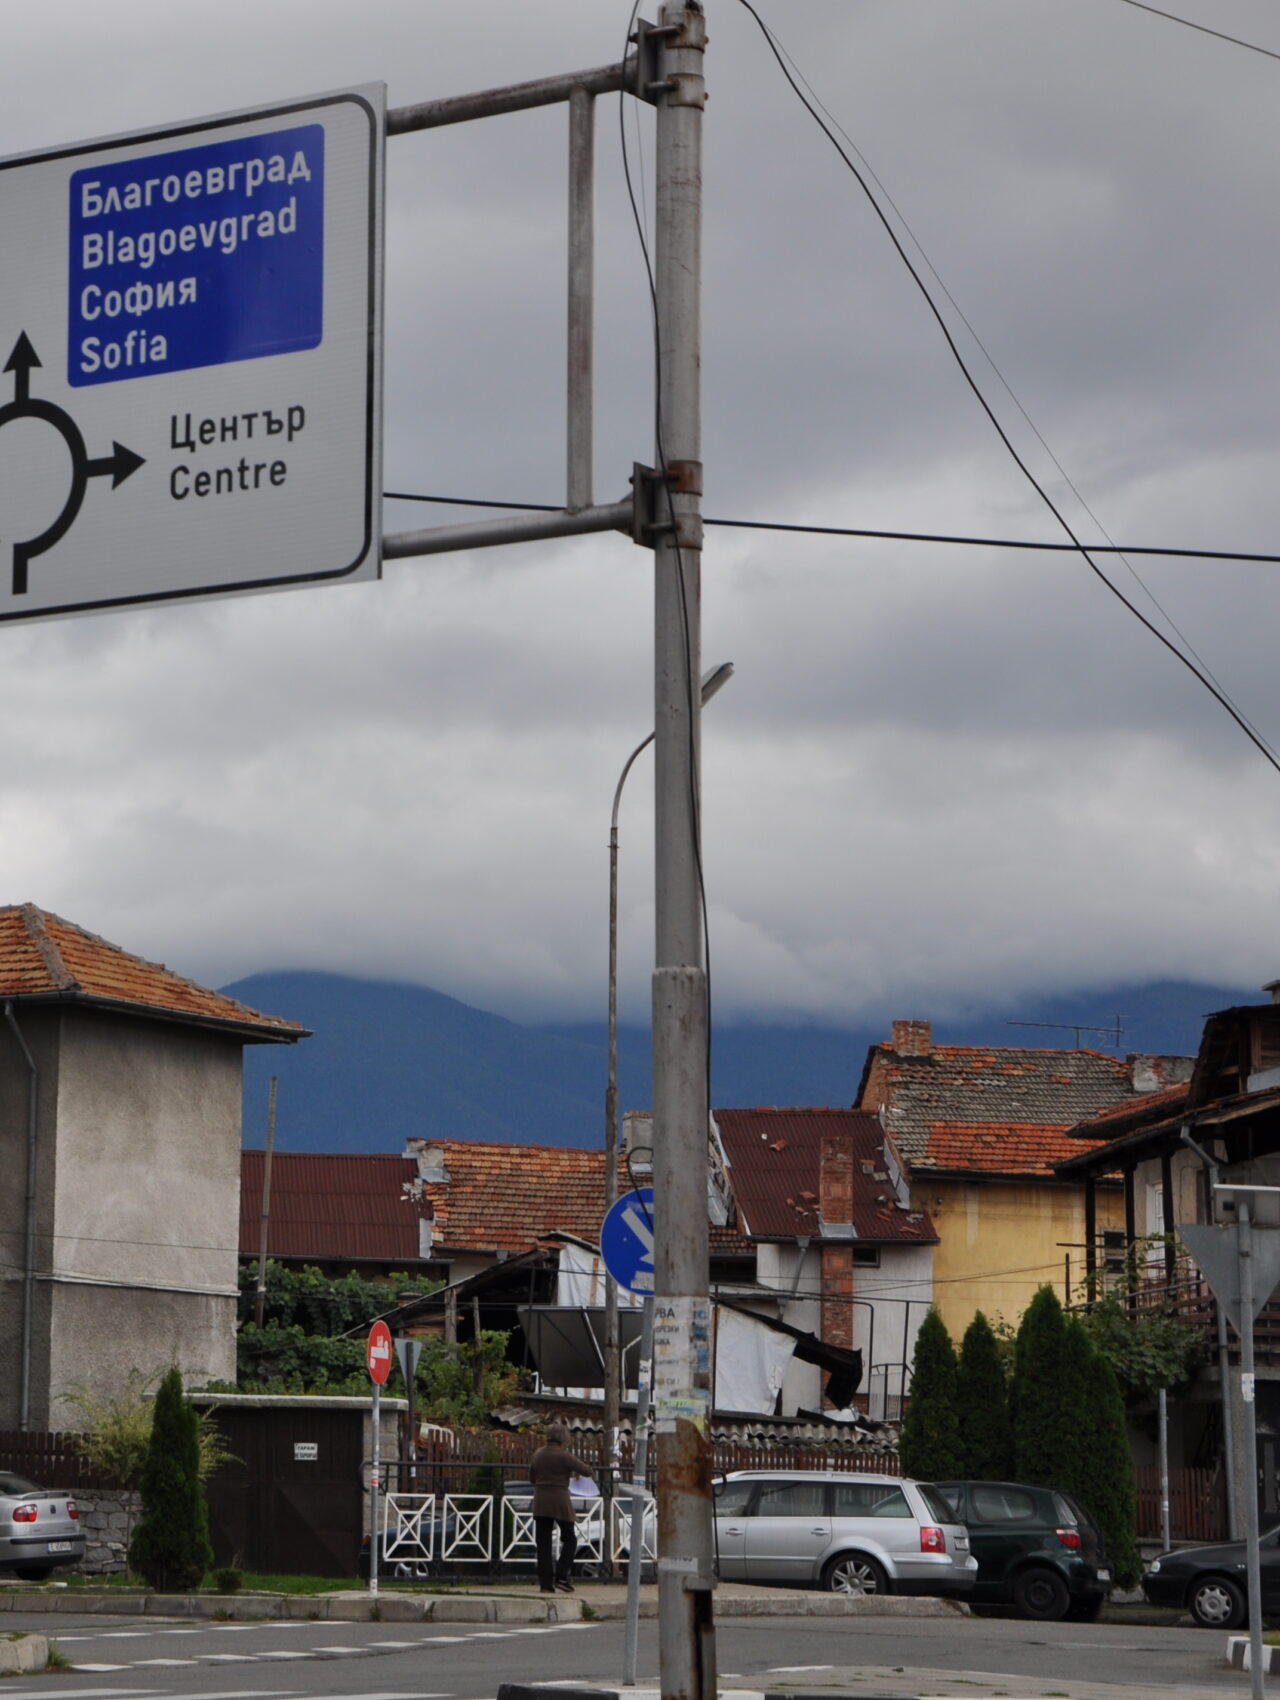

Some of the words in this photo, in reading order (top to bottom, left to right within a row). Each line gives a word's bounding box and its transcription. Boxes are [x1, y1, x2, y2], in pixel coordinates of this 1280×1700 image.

[81, 149, 312, 219] Благоевград
[81, 197, 297, 270] Blagoevgrad
[80, 276, 197, 322] София
[80, 330, 168, 374] Sofia
[170, 403, 306, 454] Център
[169, 456, 288, 501] Centre
